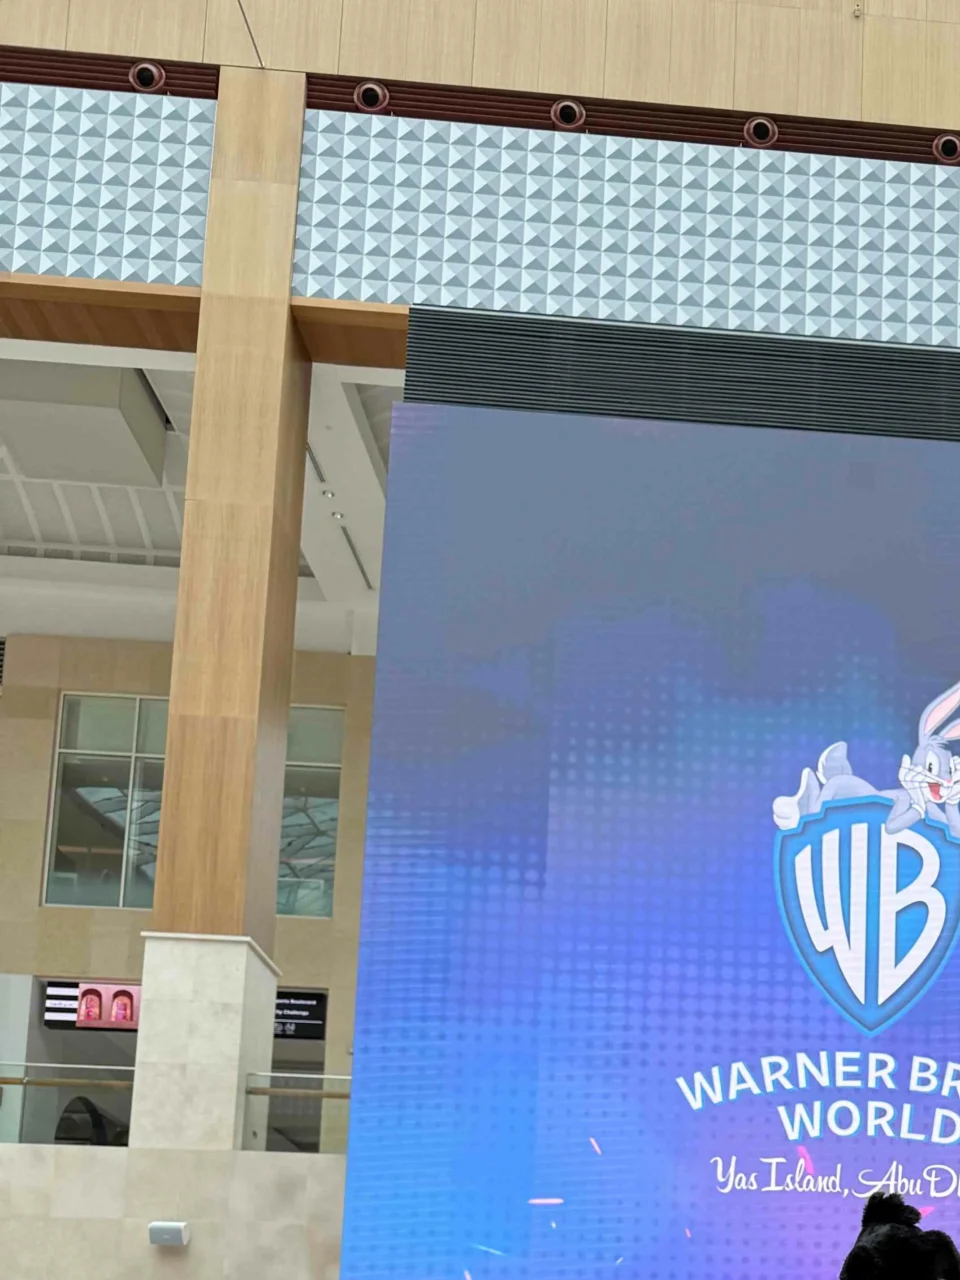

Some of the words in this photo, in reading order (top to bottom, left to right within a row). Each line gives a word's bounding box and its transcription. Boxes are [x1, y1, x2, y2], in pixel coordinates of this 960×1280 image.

[795, 822, 947, 1006] WB
[676, 1050, 899, 1111] WARNER
[710, 1155, 759, 1194] Yas
[760, 1157, 850, 1198] Island,
[851, 1160, 924, 1198] Abu
